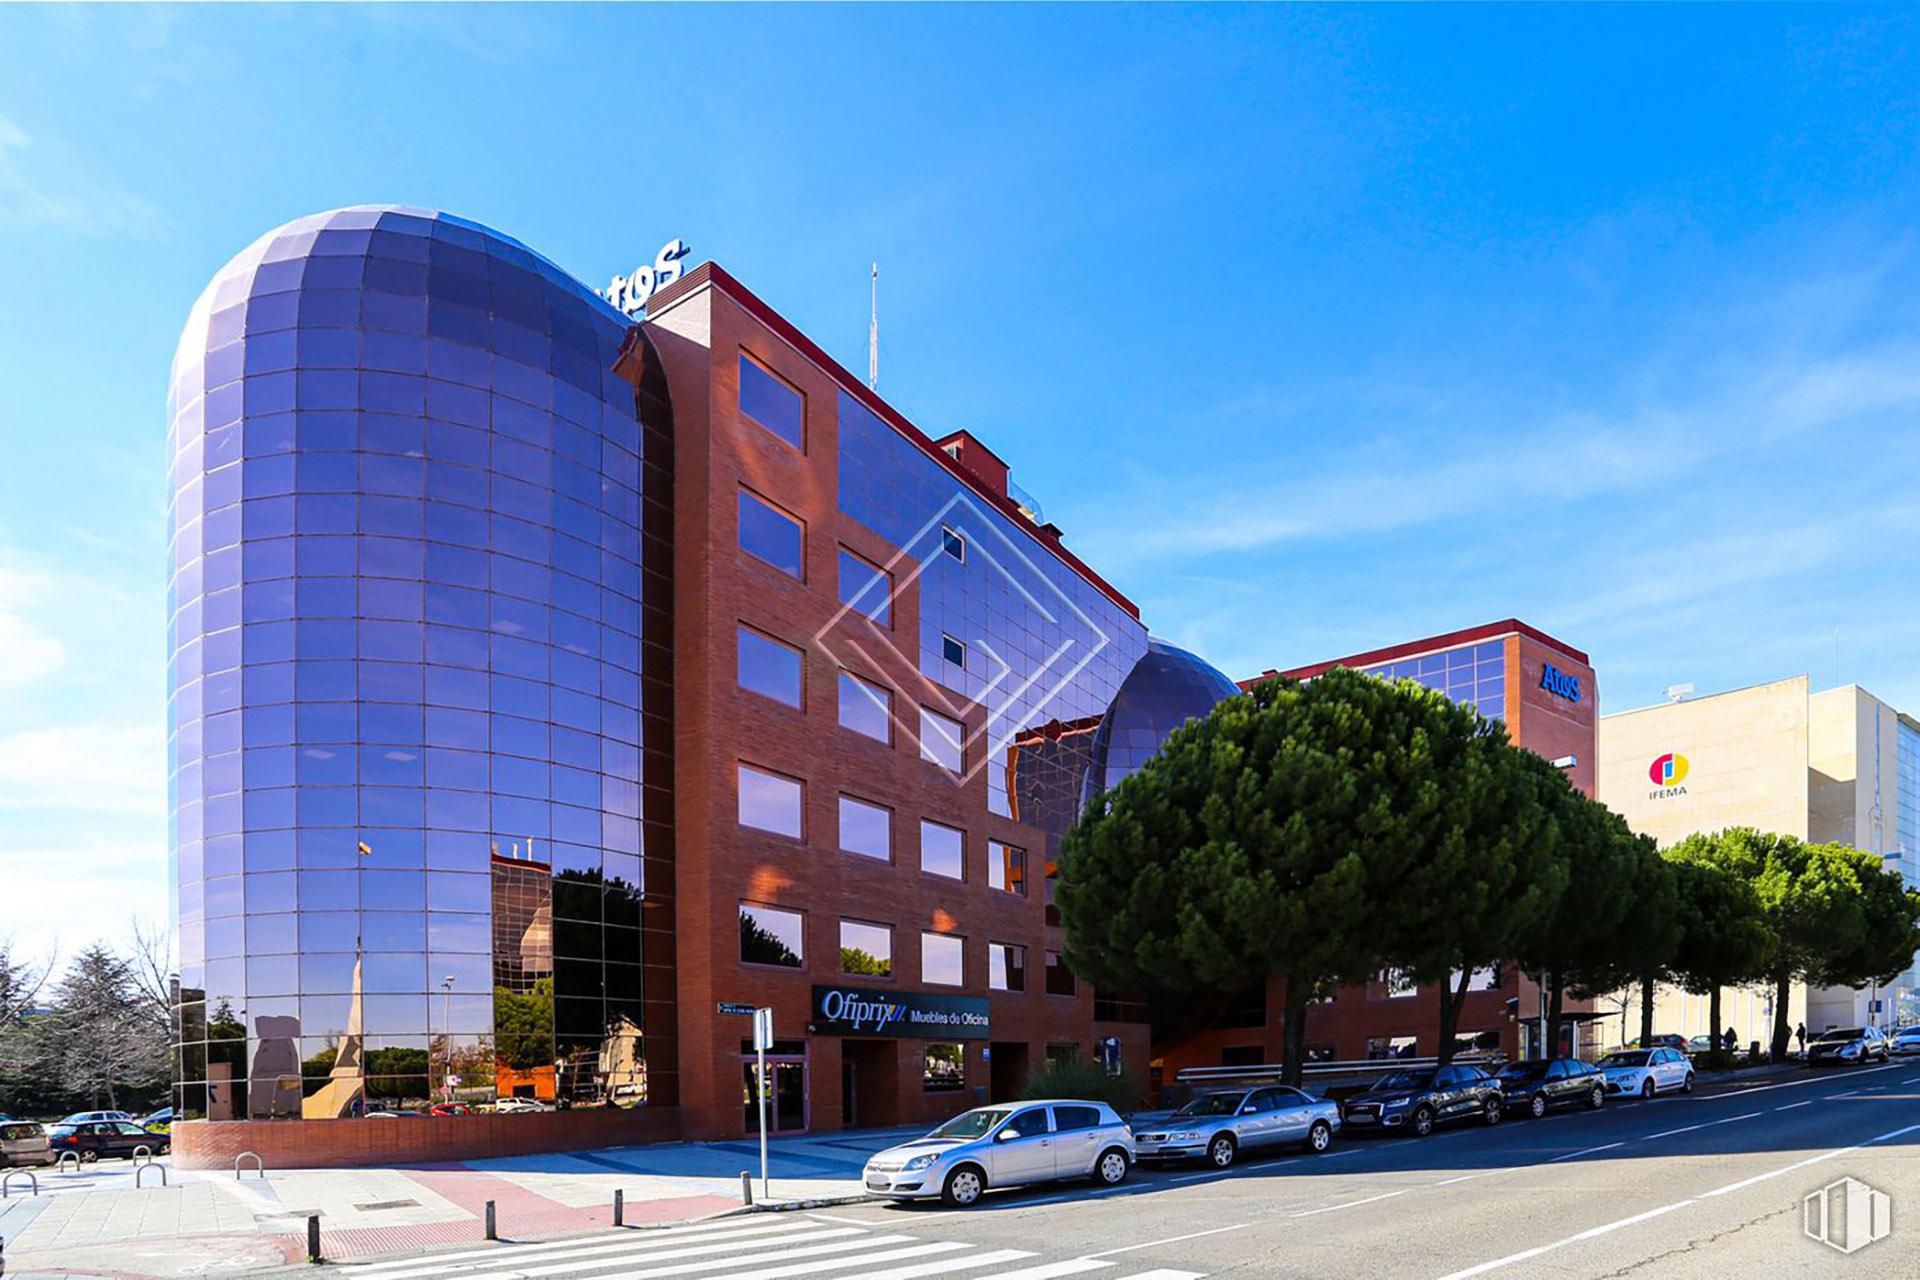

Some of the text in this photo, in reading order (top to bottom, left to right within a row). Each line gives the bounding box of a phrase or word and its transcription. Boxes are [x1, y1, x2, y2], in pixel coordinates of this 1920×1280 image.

[595, 239, 690, 314] tos
[1540, 662, 1581, 702] Atos
[1649, 786, 1687, 800] IFEMA
[823, 990, 989, 1032] Ofiprix Muebles de Oficina
